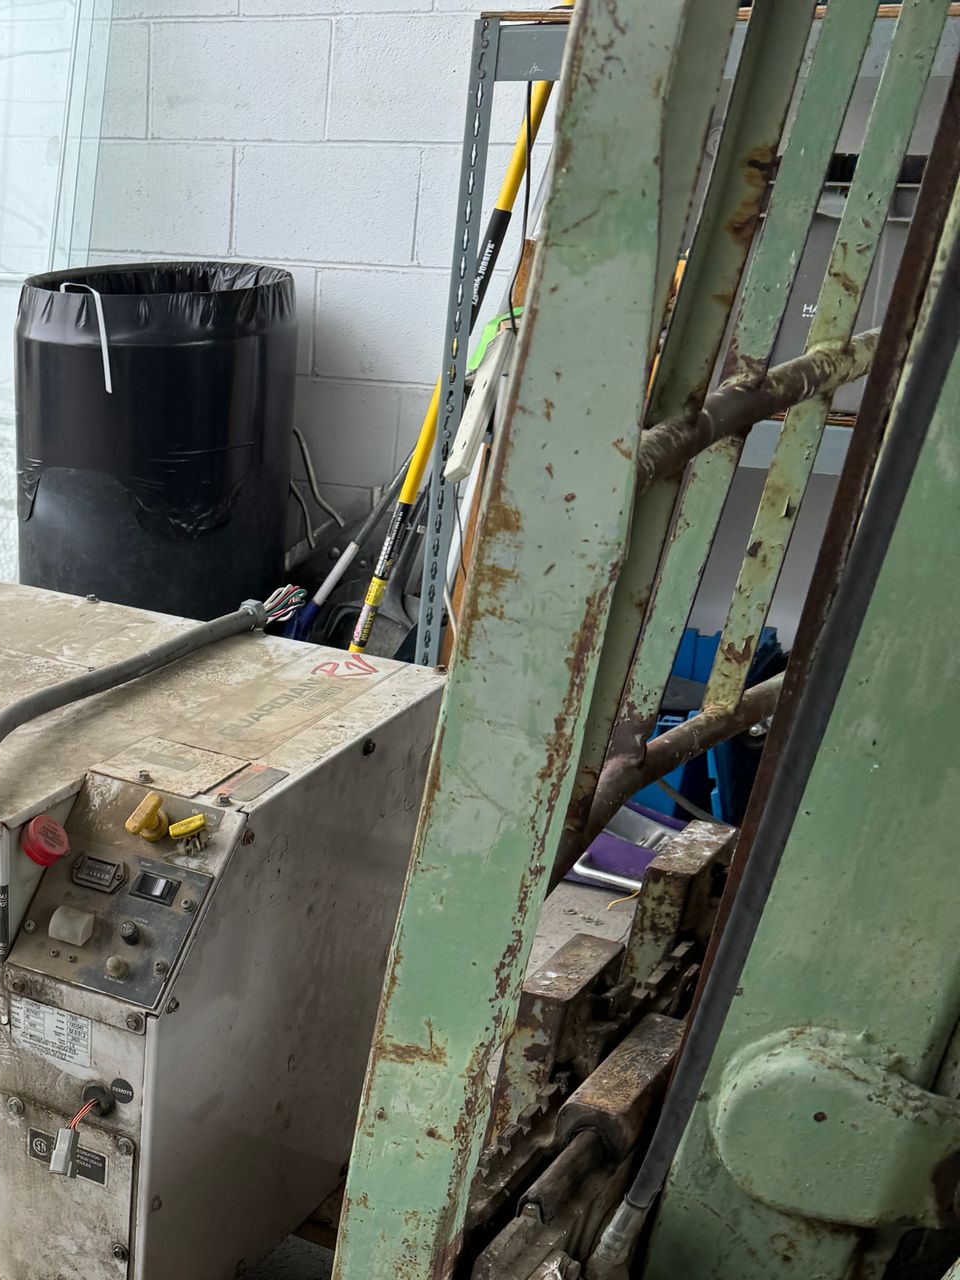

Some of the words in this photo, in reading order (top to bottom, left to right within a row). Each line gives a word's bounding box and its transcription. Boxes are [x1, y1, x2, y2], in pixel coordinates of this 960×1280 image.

[478, 243, 495, 276] JOBSITE
[310, 654, 379, 679] RV
[217, 677, 321, 739] GUARDIAN
[112, 1086, 133, 1097] REMOTE
